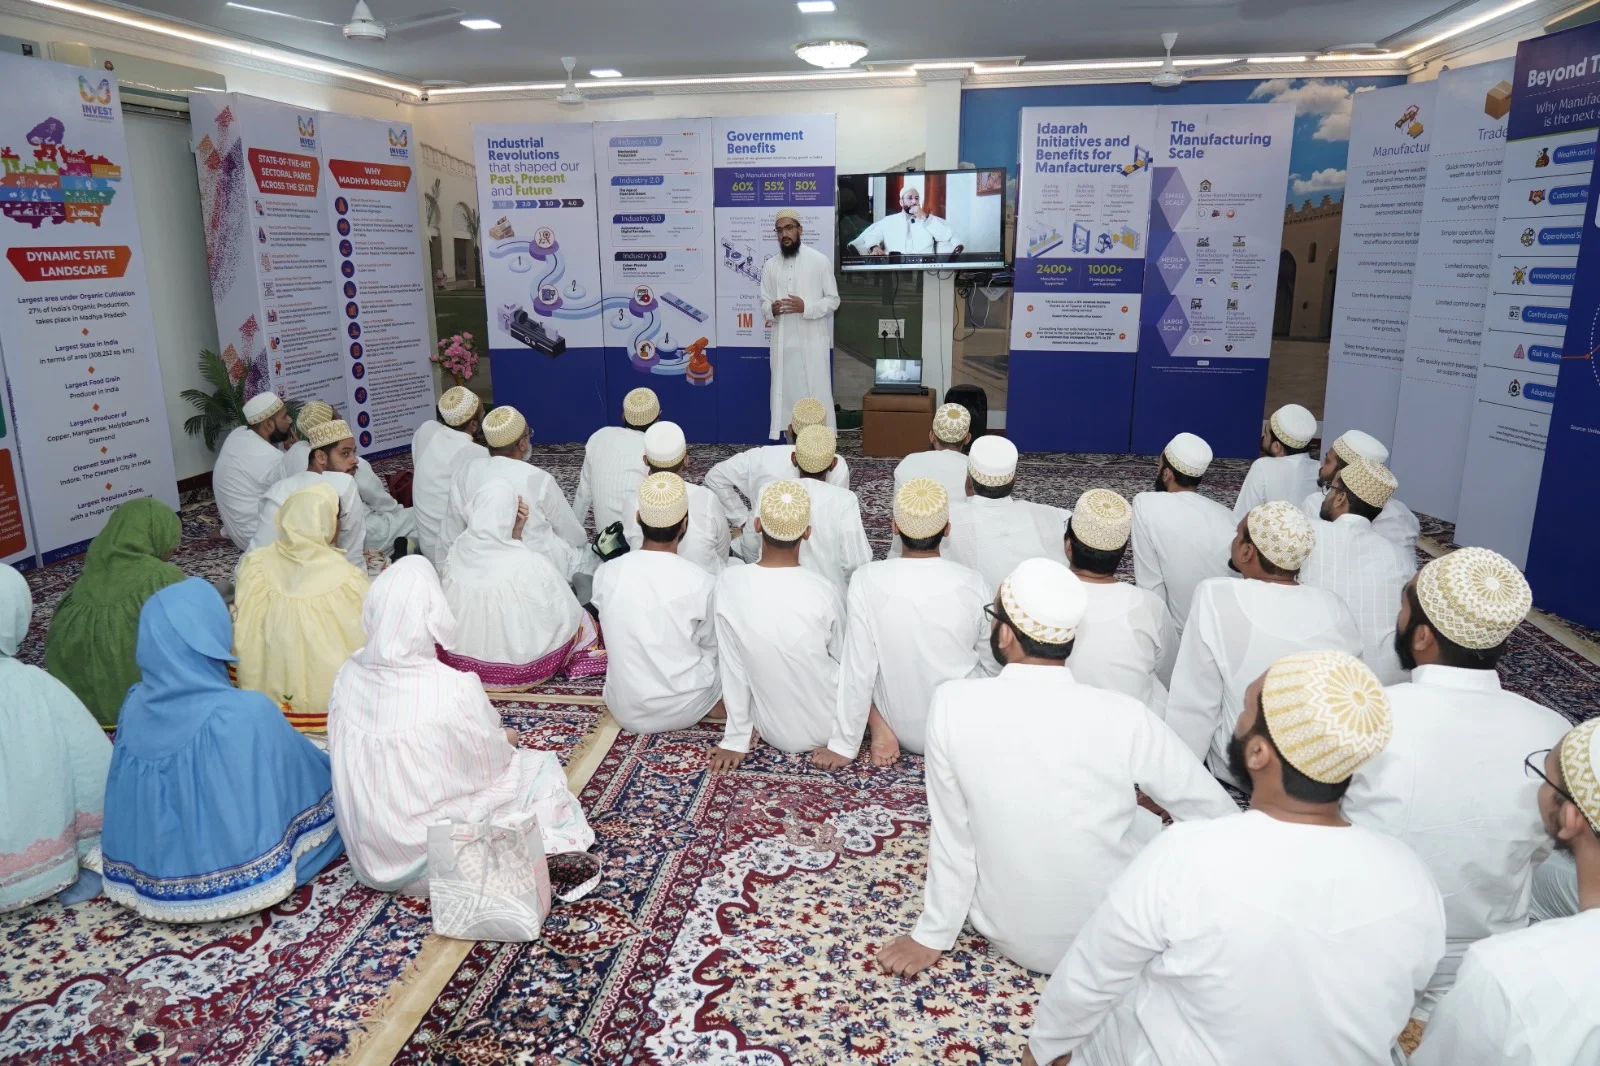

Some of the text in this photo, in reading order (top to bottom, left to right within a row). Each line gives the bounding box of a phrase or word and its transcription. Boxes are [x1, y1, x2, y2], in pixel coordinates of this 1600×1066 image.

[1528, 57, 1588, 87] Beyond
[82, 104, 112, 116] INVEST
[1536, 101, 1557, 115] Why
[1544, 108, 1594, 127] is the next
[1037, 122, 1087, 134] Idaarah
[1171, 121, 1195, 132] The
[727, 130, 803, 141] Government
[1037, 135, 1130, 147] Initiatives and
[1170, 133, 1271, 147] Manufacturing
[488, 137, 543, 148] Industrial
[728, 142, 776, 154] Benefits
[488, 150, 559, 160] Revolutions
[1036, 148, 1112, 160] Benefits for
[1169, 147, 1204, 158] Scale
[259, 155, 311, 168] STATE-OF-THE-ART
[489, 161, 579, 174] that shaped our
[1035, 162, 1122, 173] Manfacturers
[262, 168, 311, 180] SECTORAL PARKS
[365, 167, 380, 175] WHY
[339, 177, 369, 186] MADHYA
[371, 178, 401, 187] PRADESH
[490, 174, 565, 185] Past, Present
[796, 181, 816, 190] 50%
[261, 182, 285, 190] ACROSS
[298, 184, 314, 192] STATE
[492, 183, 552, 196] and Future
[732, 182, 753, 191] 60%
[764, 181, 784, 191] 55%
[27, 250, 115, 262] DYNAMIC STATE
[518, 256, 521, 266] 1
[41, 265, 108, 277] LANDSCAPE
[1036, 265, 1072, 274] 2400+
[1088, 264, 1123, 274] 1000+
[572, 280, 576, 292] 2
[18, 297, 43, 305] Largest
[55, 316, 71, 324] place
[618, 308, 624, 321] 3
[737, 313, 752, 328] 1M
[664, 332, 669, 344] 4
[70, 419, 92, 427] Largest
[94, 414, 119, 422] Producer
[47, 433, 71, 442] Copper,
[72, 427, 107, 437] Manganese,
[109, 420, 144, 430] Molybdenum
[89, 435, 115, 444] Diamond
[74, 462, 99, 472] Cleanest
[60, 476, 81, 485] Indore,
[95, 468, 118, 477] Cleanest
[120, 464, 130, 472] City
[78, 500, 100, 509] Largest
[101, 492, 127, 503] Populous
[90, 508, 104, 516] huge
